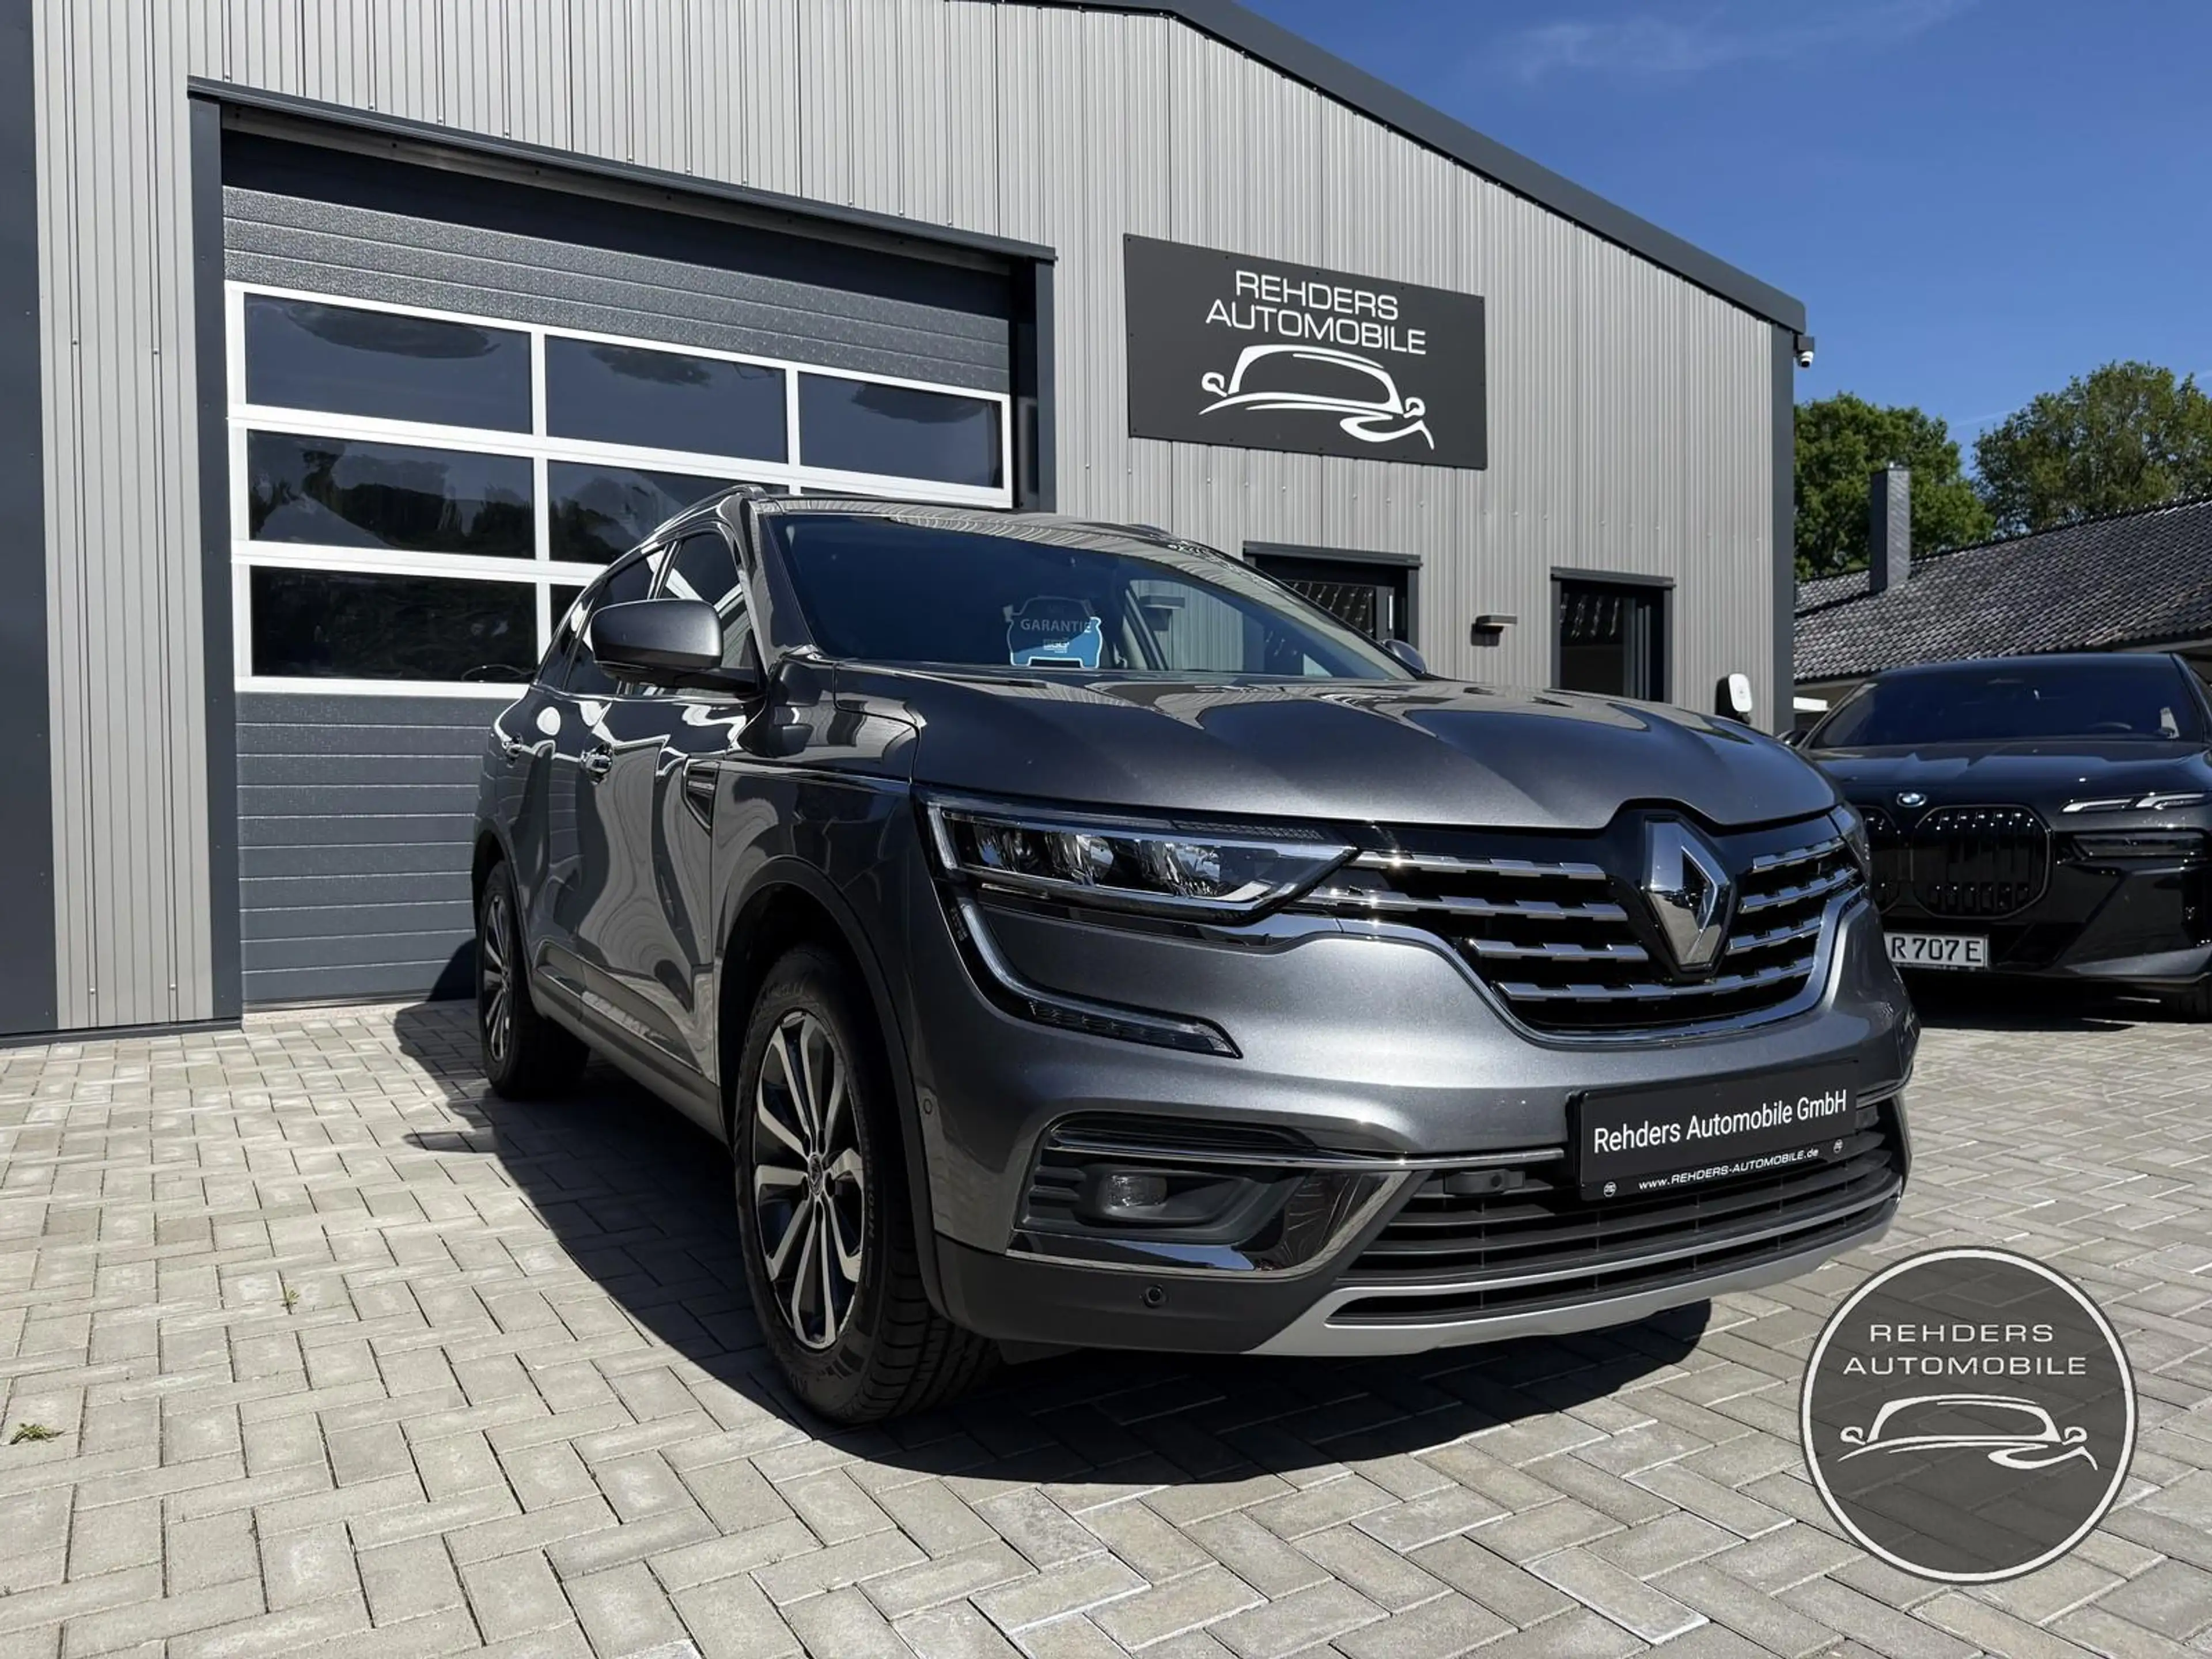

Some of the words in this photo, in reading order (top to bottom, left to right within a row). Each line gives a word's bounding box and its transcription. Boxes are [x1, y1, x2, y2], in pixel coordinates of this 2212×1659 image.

[1235, 270, 1399, 321] REHDERS
[1205, 298, 1427, 355] AUTOMOBILE
[1020, 618, 1092, 633] GARANTIE
[1594, 1120, 1681, 1154] Rehders
[1686, 1100, 1793, 1140] Automobile
[1797, 1089, 1846, 1121] GmbH
[1638, 1147, 1819, 1191] www.REHDERS-AUTOMOBILE.de
